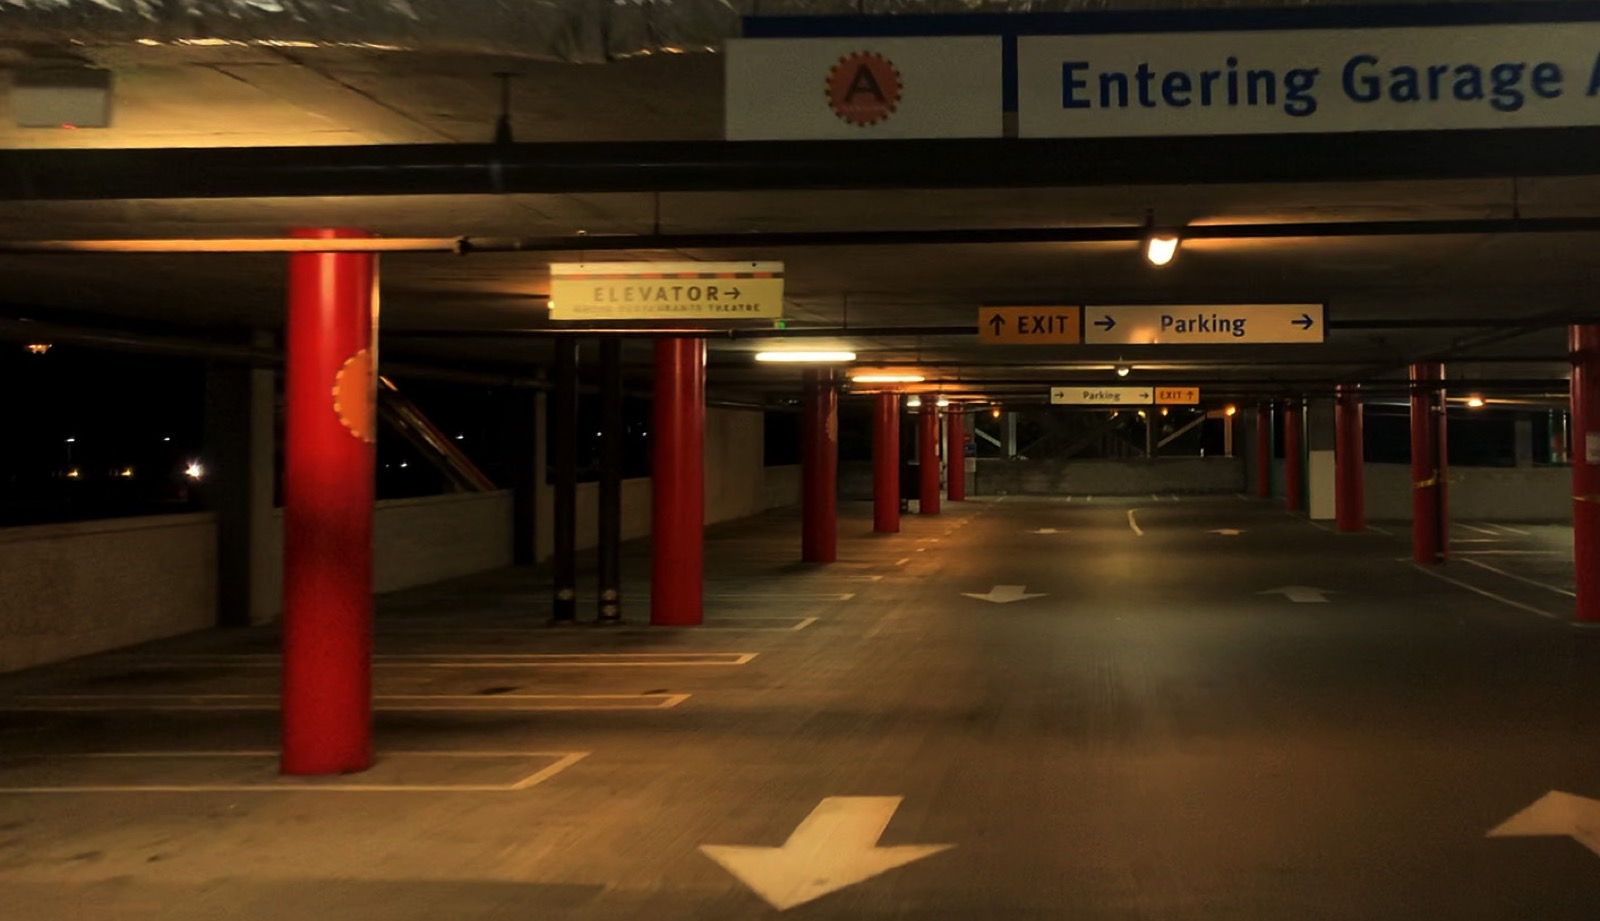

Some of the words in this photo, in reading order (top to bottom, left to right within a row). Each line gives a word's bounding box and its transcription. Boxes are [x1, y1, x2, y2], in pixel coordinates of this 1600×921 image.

[843, 63, 887, 103] A
[1061, 56, 1320, 117] Entering
[1342, 54, 1563, 112] Garage
[594, 286, 719, 302] ELEVATOR
[1017, 315, 1068, 335] EXIT
[1160, 314, 1246, 337] Parking
[1082, 391, 1121, 402] Parking
[1160, 391, 1182, 400] EXIT
